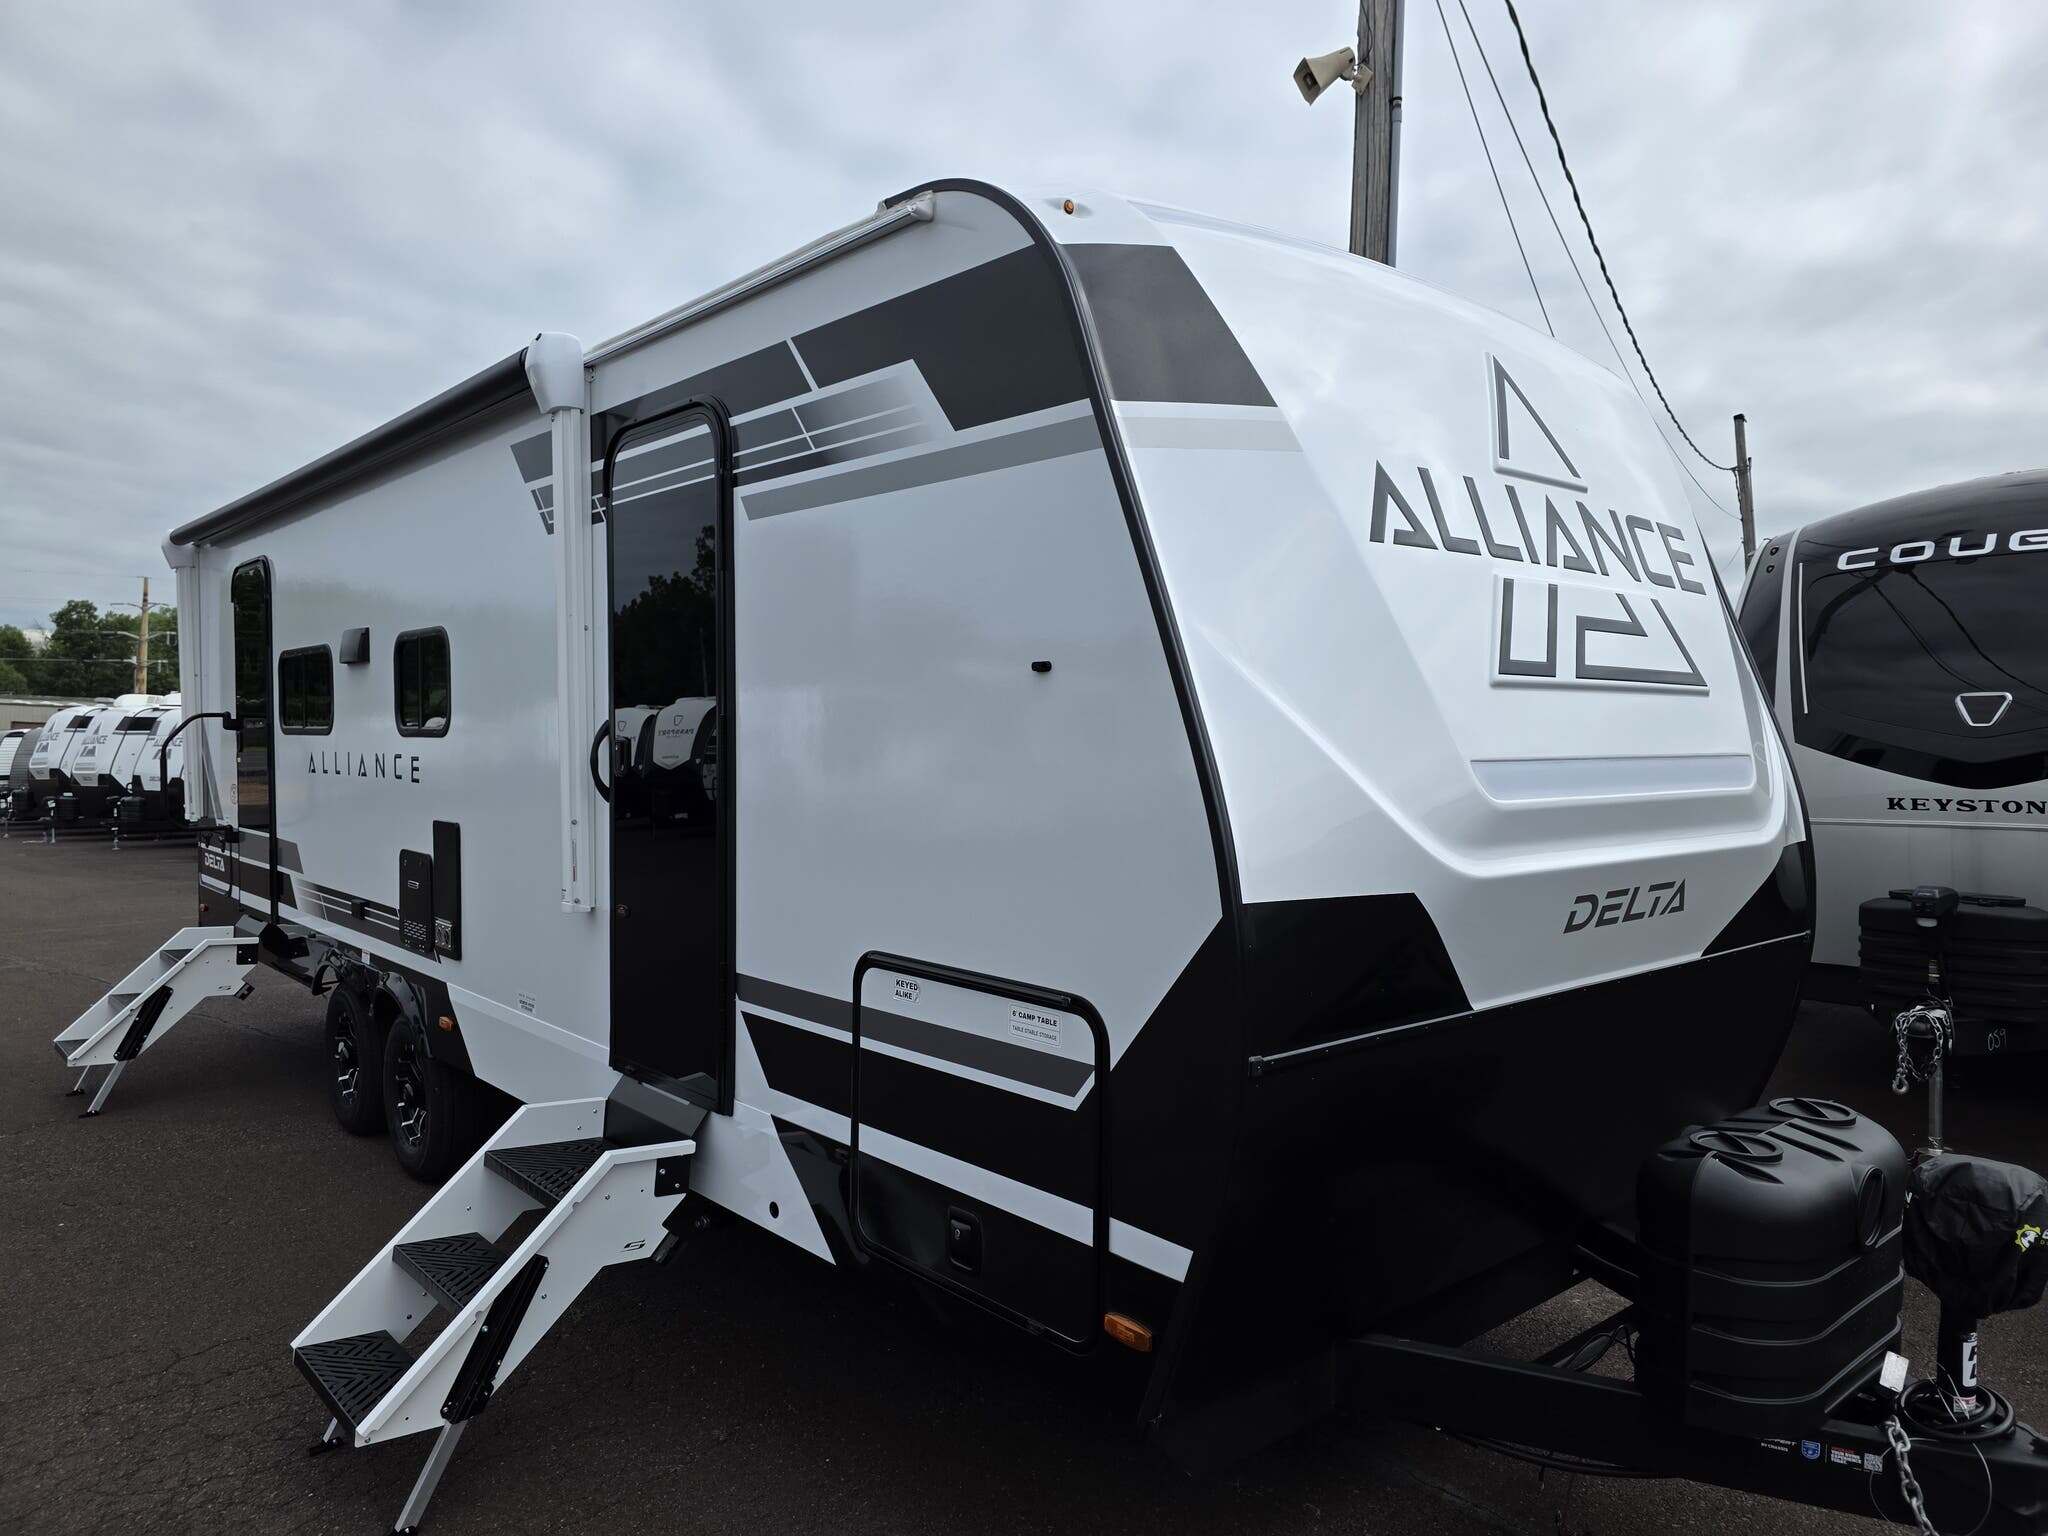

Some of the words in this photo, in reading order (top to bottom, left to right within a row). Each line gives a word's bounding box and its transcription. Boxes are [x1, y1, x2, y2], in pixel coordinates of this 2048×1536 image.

[1369, 460, 1706, 595] ALLIANCE
[1837, 529, 2048, 571] COUG
[308, 750, 420, 784] ALLIANCE
[1886, 797, 2047, 815] KEYSTON
[204, 852, 225, 872] DELTA
[1563, 879, 1686, 934] DELTA
[895, 978, 918, 991] KEYED
[895, 989, 913, 1000] ALIKE
[1018, 1011, 1036, 1022] CAMP
[1037, 1015, 1058, 1027] TABLE
[1012, 1025, 1024, 1033] TABLE
